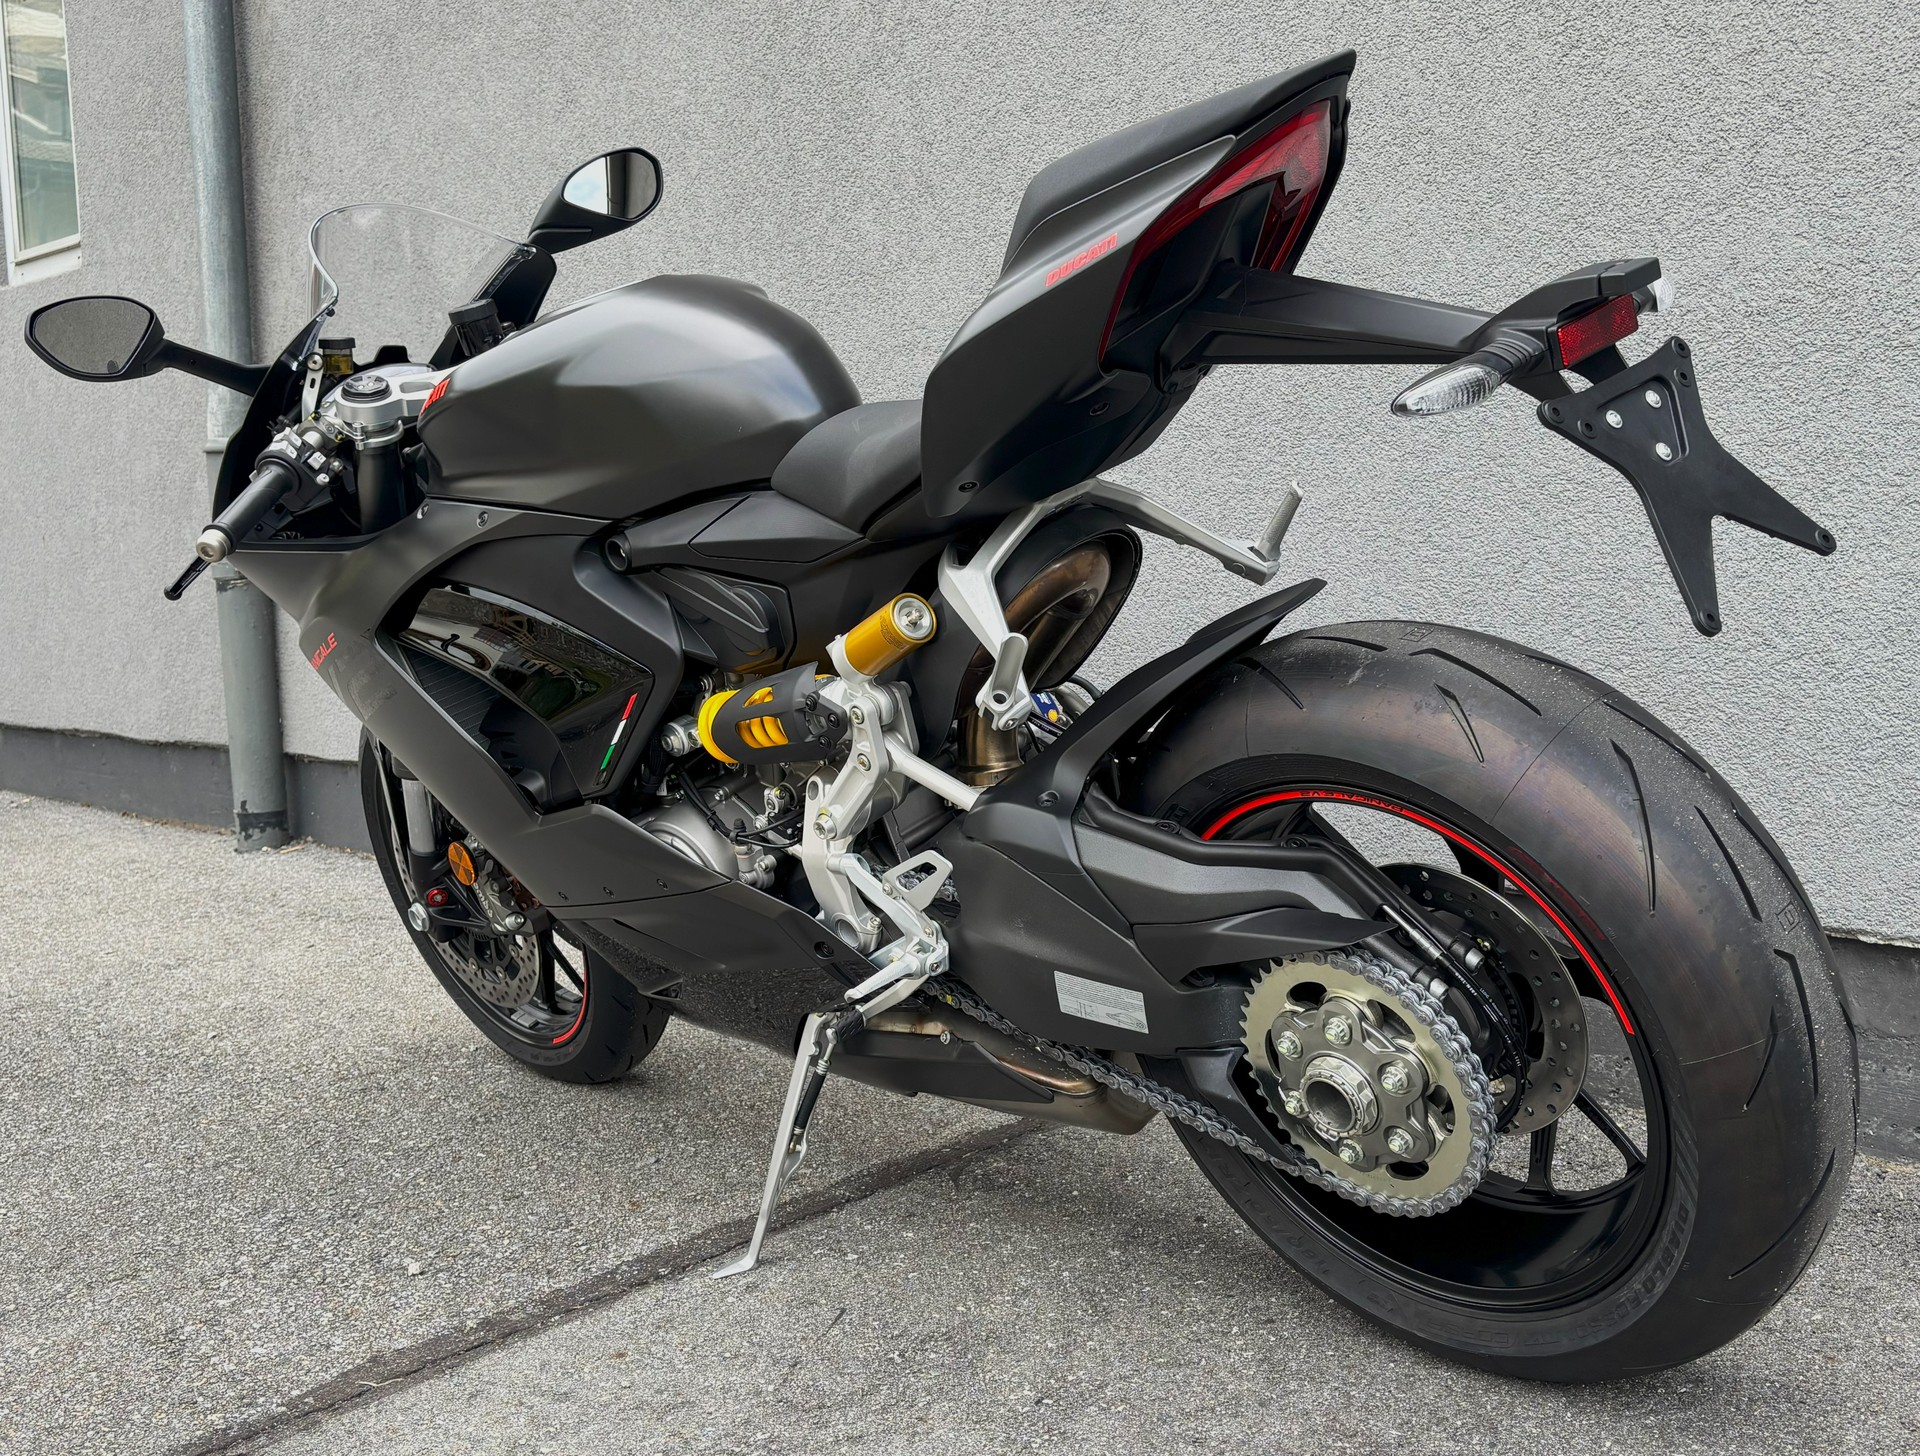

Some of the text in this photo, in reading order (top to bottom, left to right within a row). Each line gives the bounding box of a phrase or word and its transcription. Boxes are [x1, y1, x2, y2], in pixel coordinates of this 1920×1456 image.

[1045, 232, 1118, 288] DUCATI
[1323, 791, 1405, 813] PANIGALE
[1642, 1200, 1690, 1294] DIABLO
